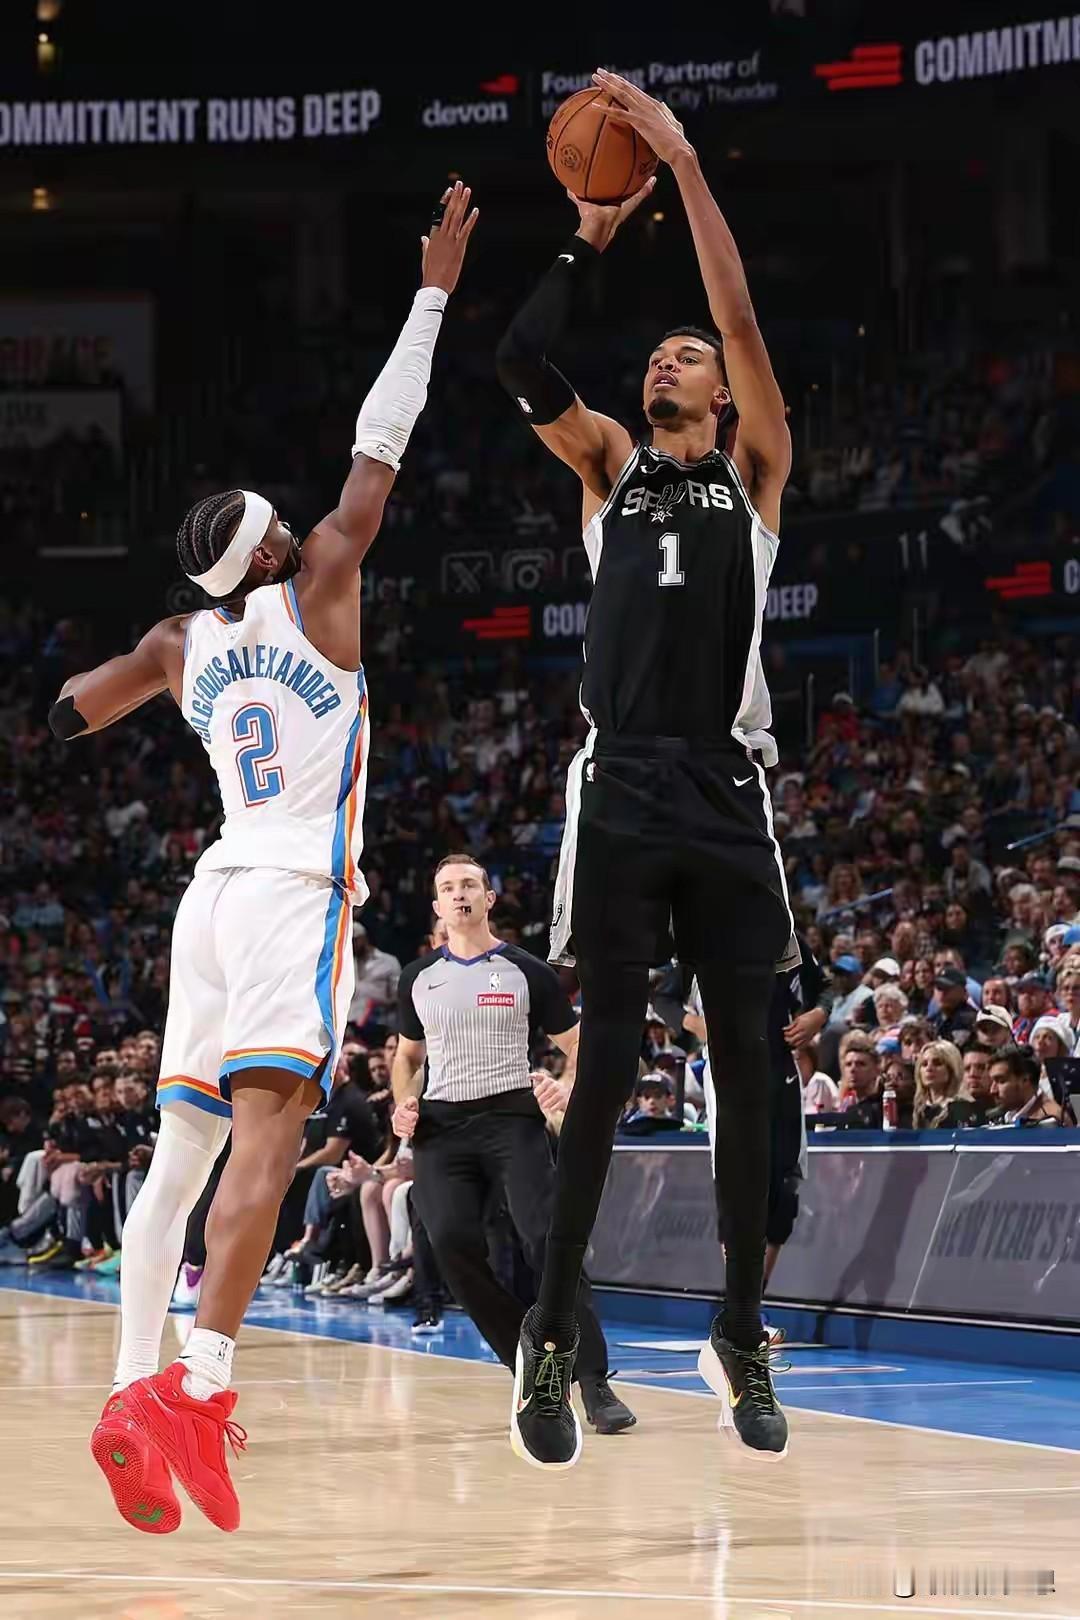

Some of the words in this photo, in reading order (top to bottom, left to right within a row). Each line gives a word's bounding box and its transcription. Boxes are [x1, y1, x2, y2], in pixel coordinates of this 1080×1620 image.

[648, 60, 736, 85] Partner
[737, 47, 761, 78] of
[207, 96, 296, 142] RUNS
[303, 89, 380, 137] DEEP
[423, 99, 509, 127] devon
[658, 532, 685, 587] 1
[765, 583, 819, 621] DEEP
[231, 702, 286, 808] 2
[478, 995, 514, 1005] Emirates
